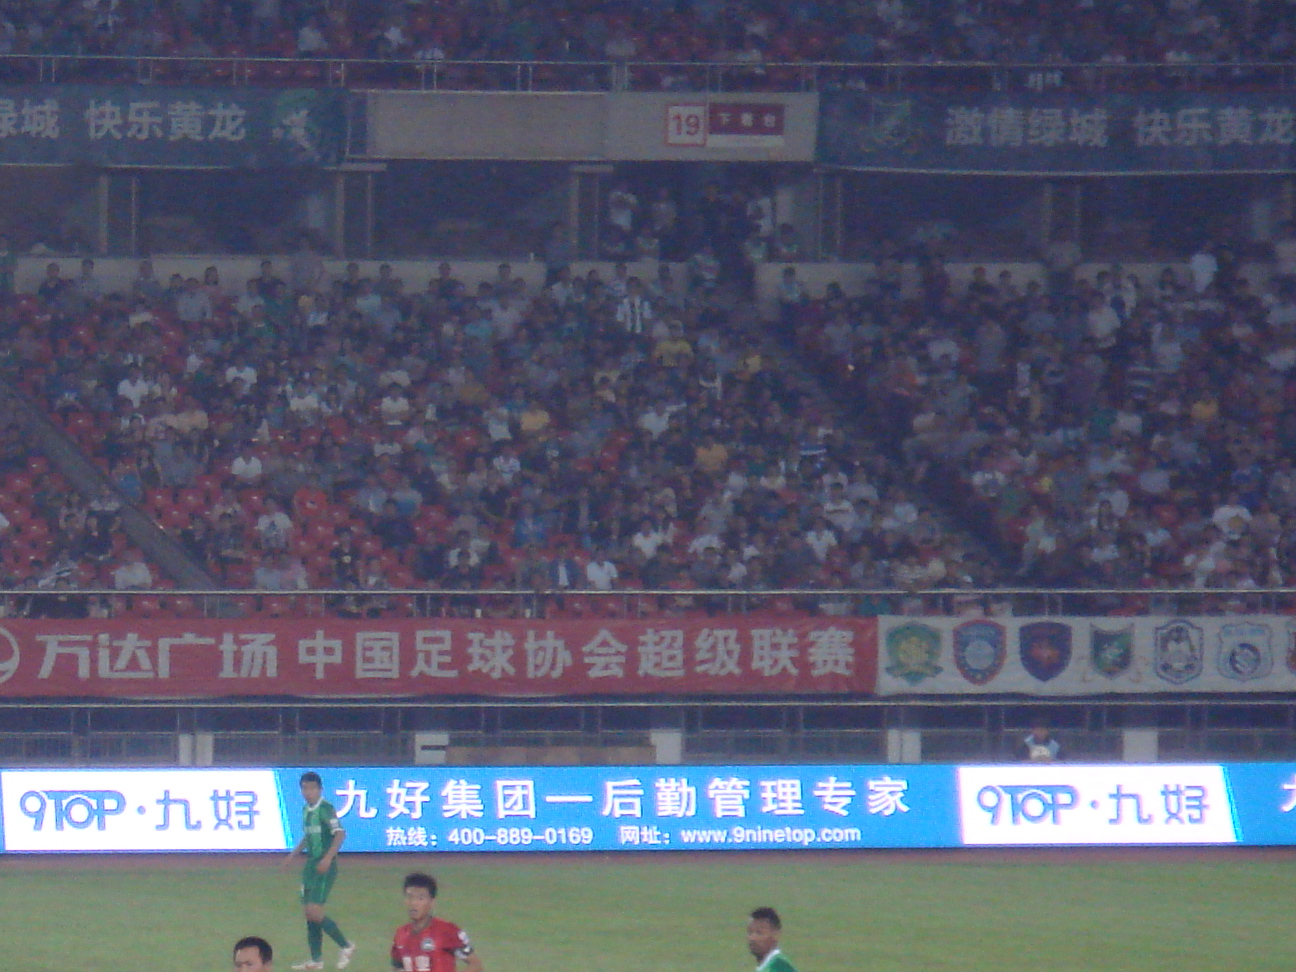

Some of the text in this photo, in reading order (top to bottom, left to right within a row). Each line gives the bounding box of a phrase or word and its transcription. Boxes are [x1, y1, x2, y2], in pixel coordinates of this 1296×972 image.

[84, 99, 247, 141] 快乐黄龙
[672, 113, 701, 136] 19
[36, 632, 278, 680] 万达广场
[298, 626, 856, 681] 中国足球协会超级联赛
